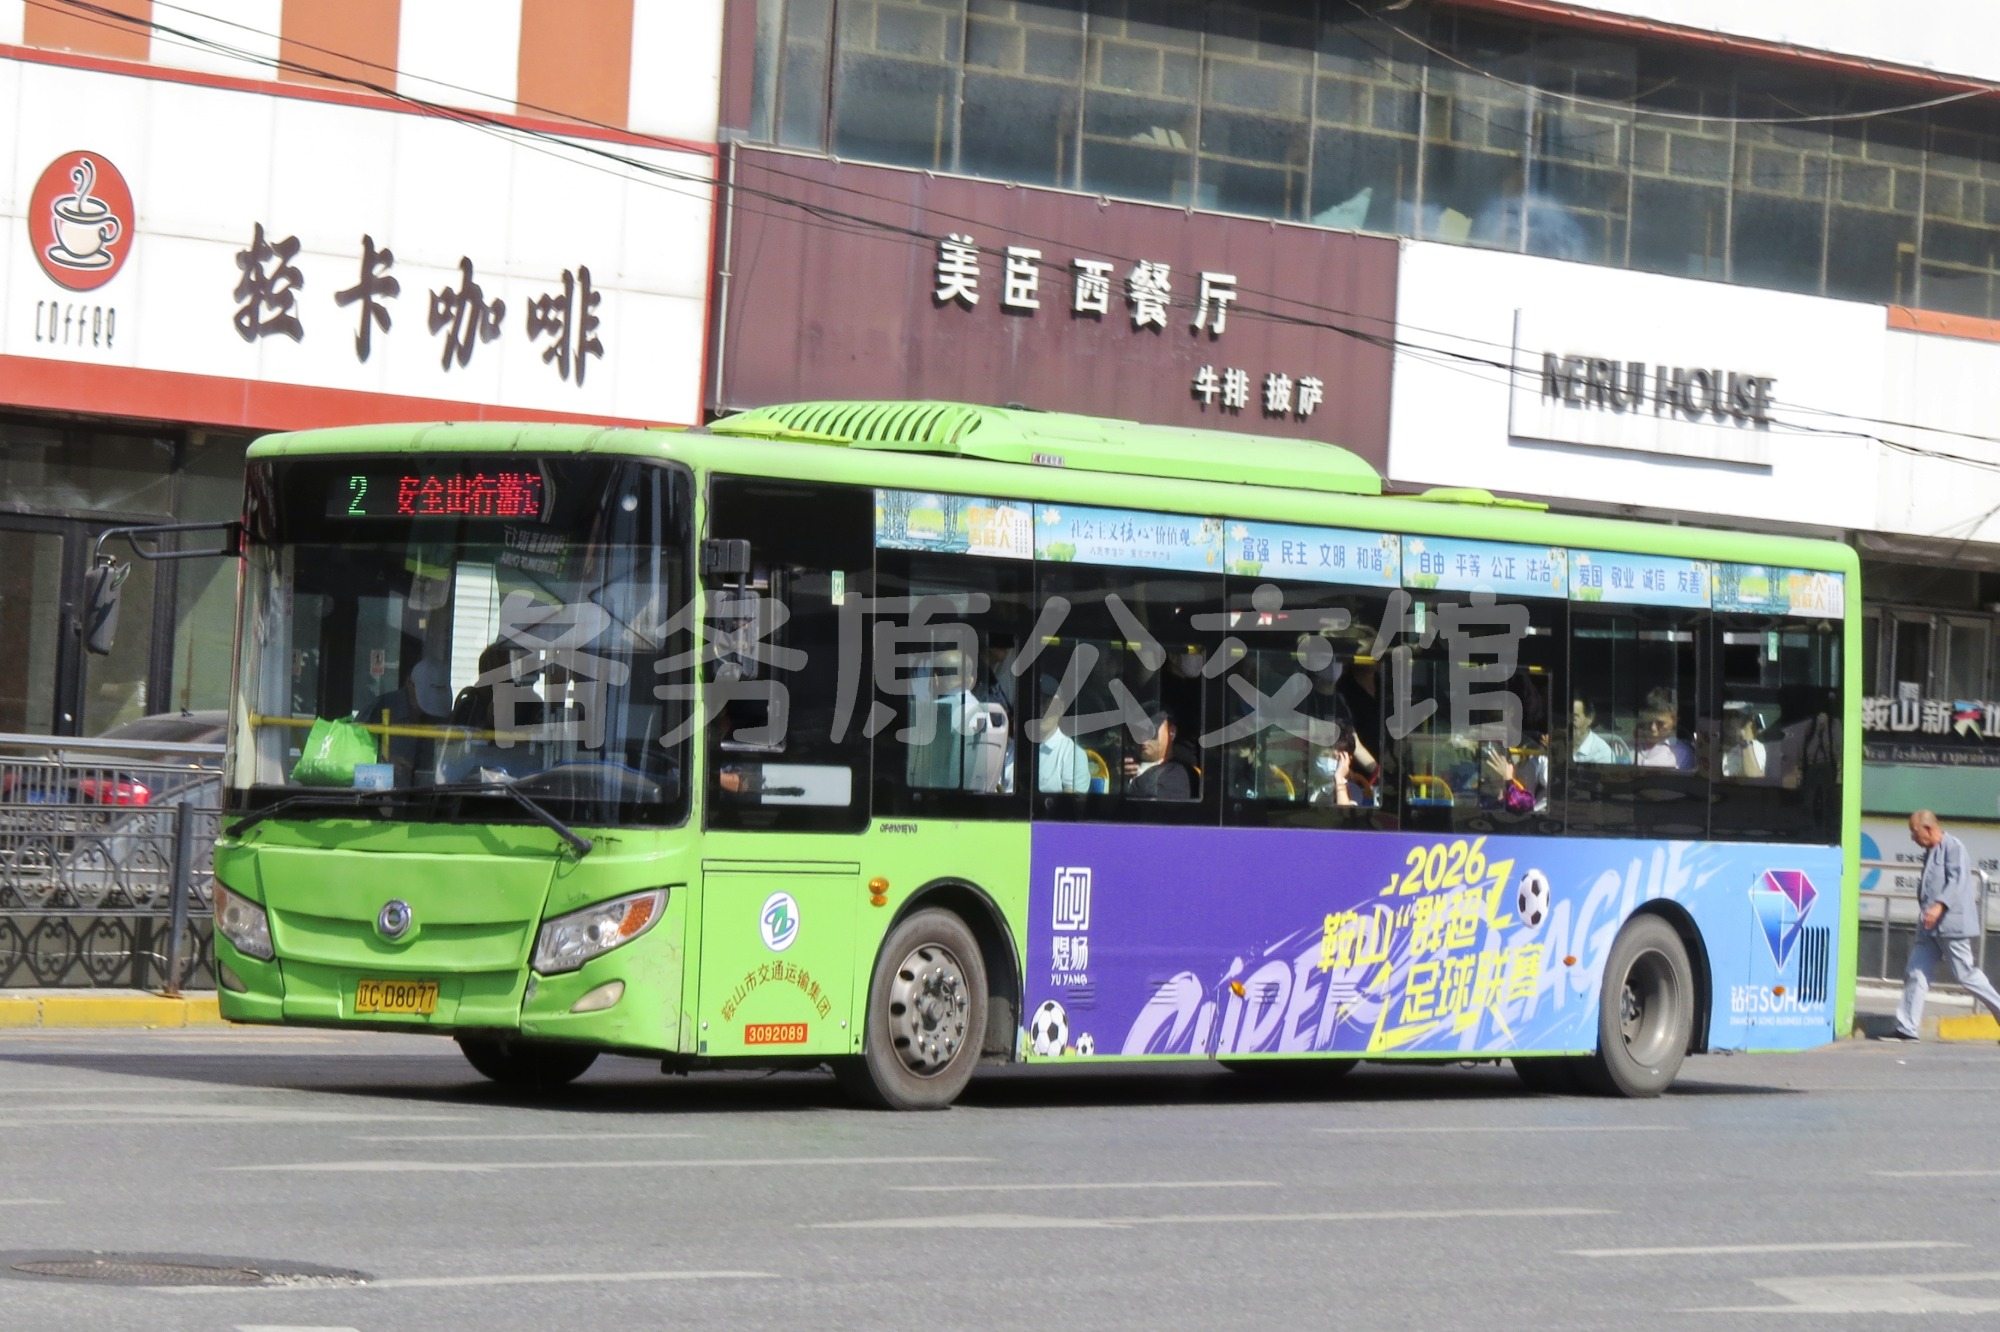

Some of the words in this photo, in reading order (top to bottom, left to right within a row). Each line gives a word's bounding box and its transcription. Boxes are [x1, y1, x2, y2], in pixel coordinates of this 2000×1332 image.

[233, 221, 605, 387] 轻卡咖啡
[935, 232, 1238, 335] 美臣西餐厅
[1193, 364, 1250, 411] 牛排
[1264, 372, 1324, 418] 披萨
[1655, 365, 1777, 430] HOUSE
[348, 476, 368, 515] 2
[1242, 537, 1269, 563] 富强
[1281, 540, 1308, 566] 民主
[1319, 543, 1346, 568] 文明
[1357, 546, 1383, 572] 和谐
[1420, 550, 1445, 575] 自由
[1456, 553, 1481, 578] 平等
[1491, 556, 1516, 581] 公正
[1526, 558, 1550, 583] 法治
[1578, 565, 1602, 588] 爱国
[1611, 566, 1634, 590] 敬业
[1642, 568, 1666, 592] 诚信
[1677, 570, 1700, 594] 友善
[1400, 836, 1488, 896] 2026
[721, 960, 832, 1022] 鞍山市交通运输集团
[1399, 942, 1545, 1023] 足球联赛
[748, 1026, 804, 1042] 3092089
